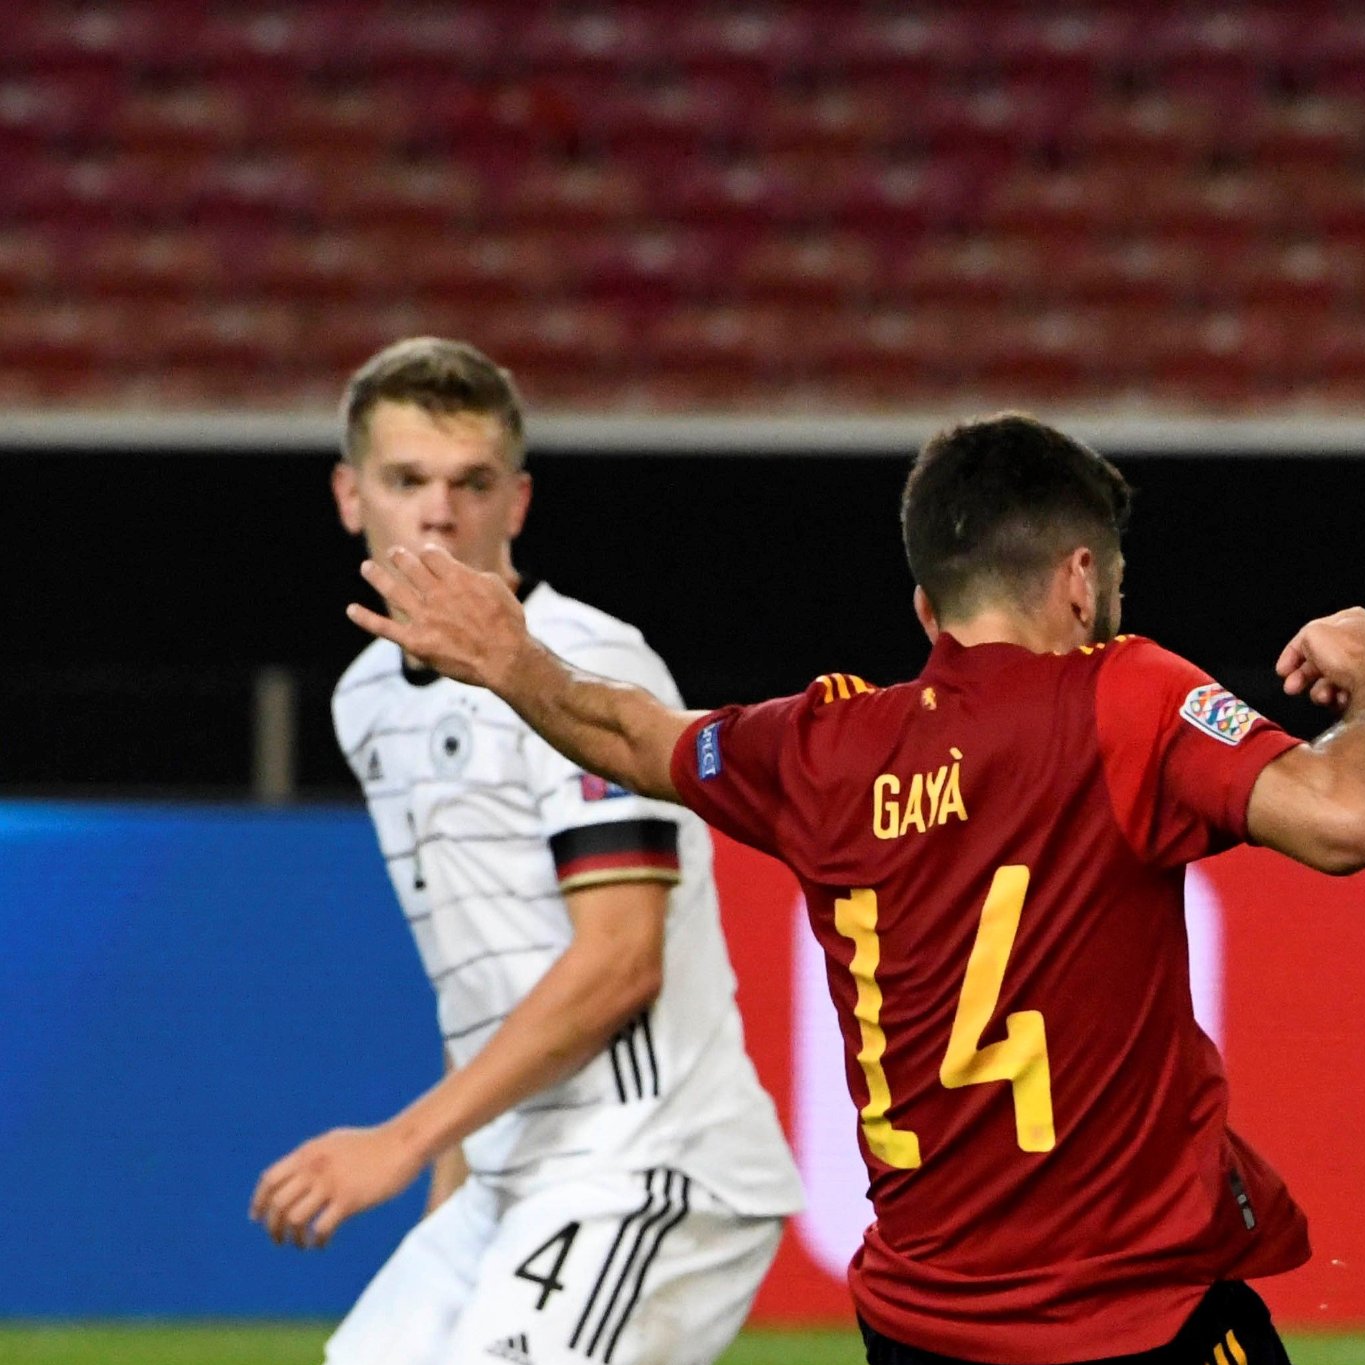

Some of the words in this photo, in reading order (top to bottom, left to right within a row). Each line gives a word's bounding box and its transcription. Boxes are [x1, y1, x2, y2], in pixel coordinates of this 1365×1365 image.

[873, 747, 968, 839] GAYÀ
[835, 865, 1056, 1169] 14
[515, 1221, 580, 1310] 4
